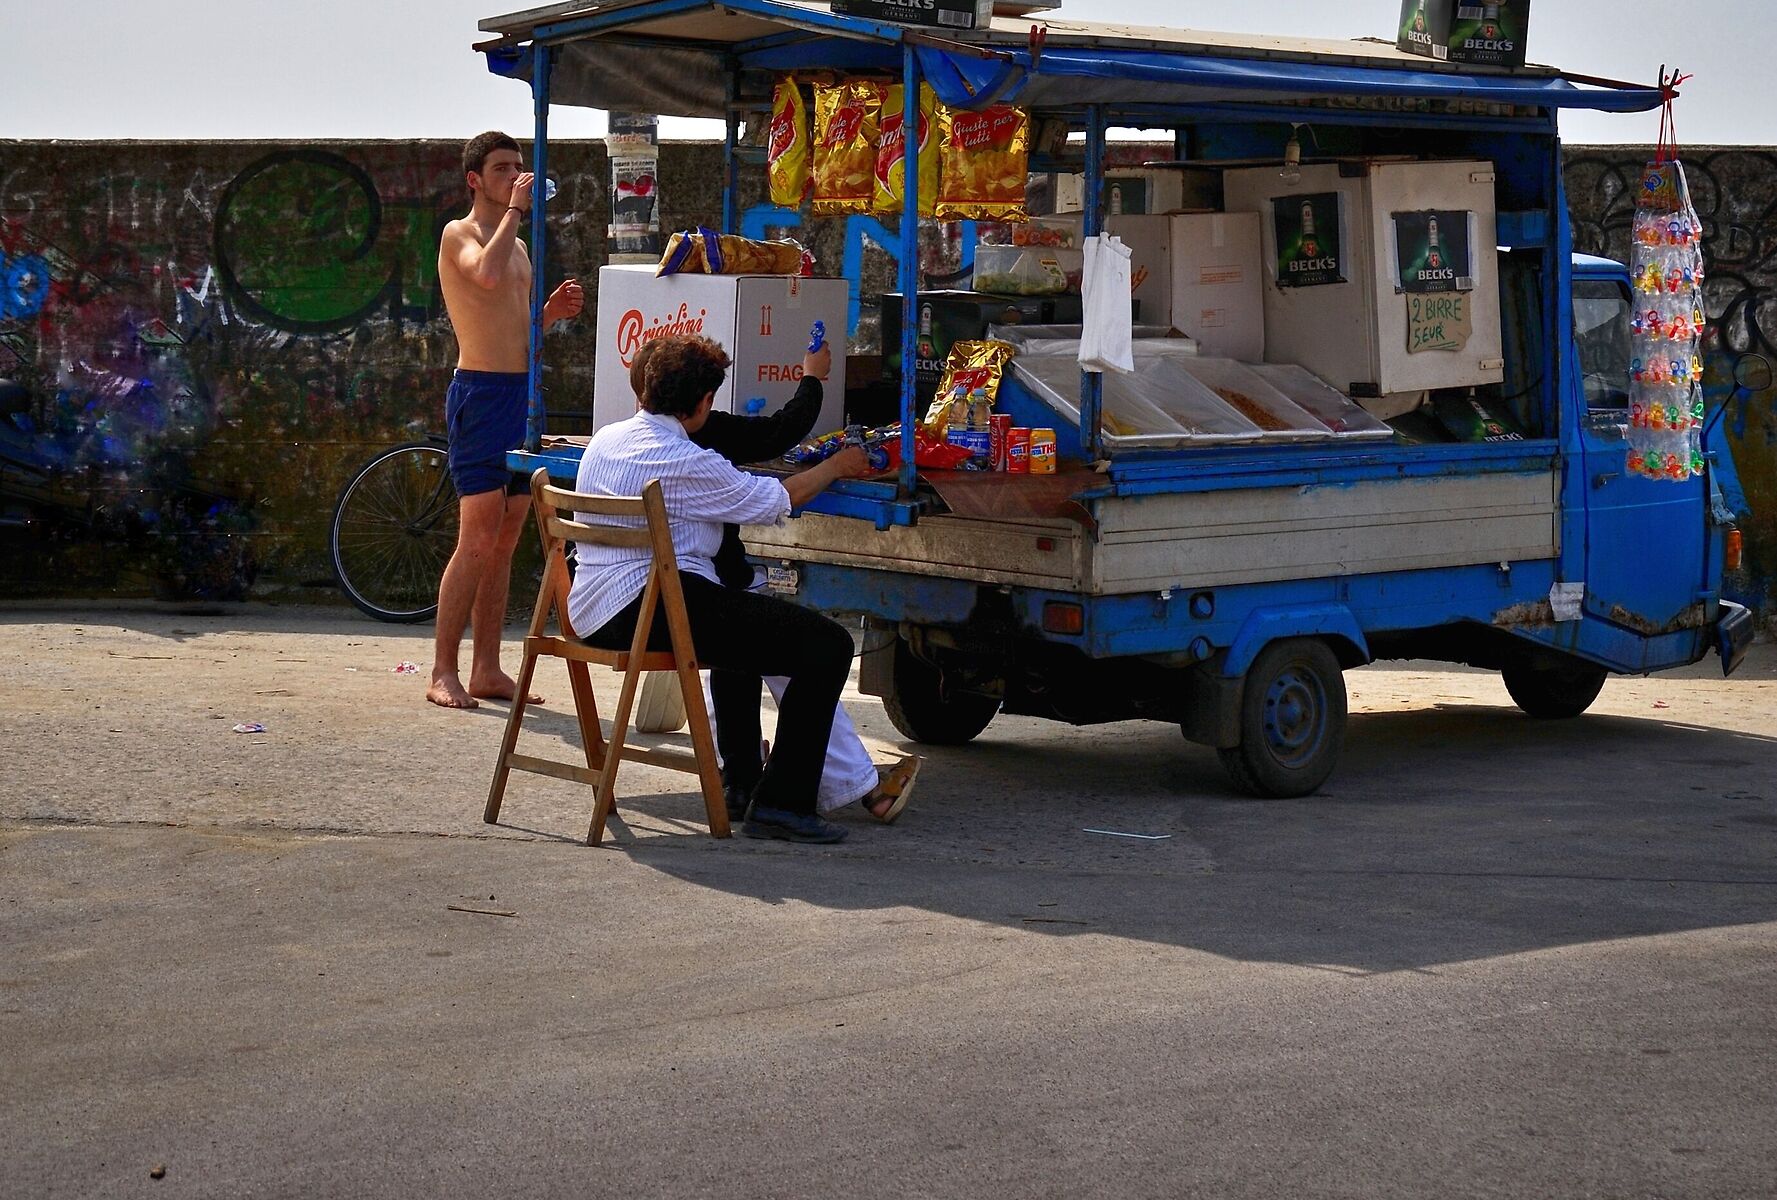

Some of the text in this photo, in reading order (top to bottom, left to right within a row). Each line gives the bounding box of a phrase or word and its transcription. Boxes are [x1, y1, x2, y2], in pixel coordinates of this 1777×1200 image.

[1408, 30, 1432, 45] BECK'S
[1463, 38, 1514, 52] BECK'S
[953, 114, 1014, 137] Giuste per
[965, 130, 991, 147] tutti
[1288, 255, 1337, 272] BECK'S
[1418, 267, 1454, 280] BECK'S
[915, 358, 946, 372] ECK'S
